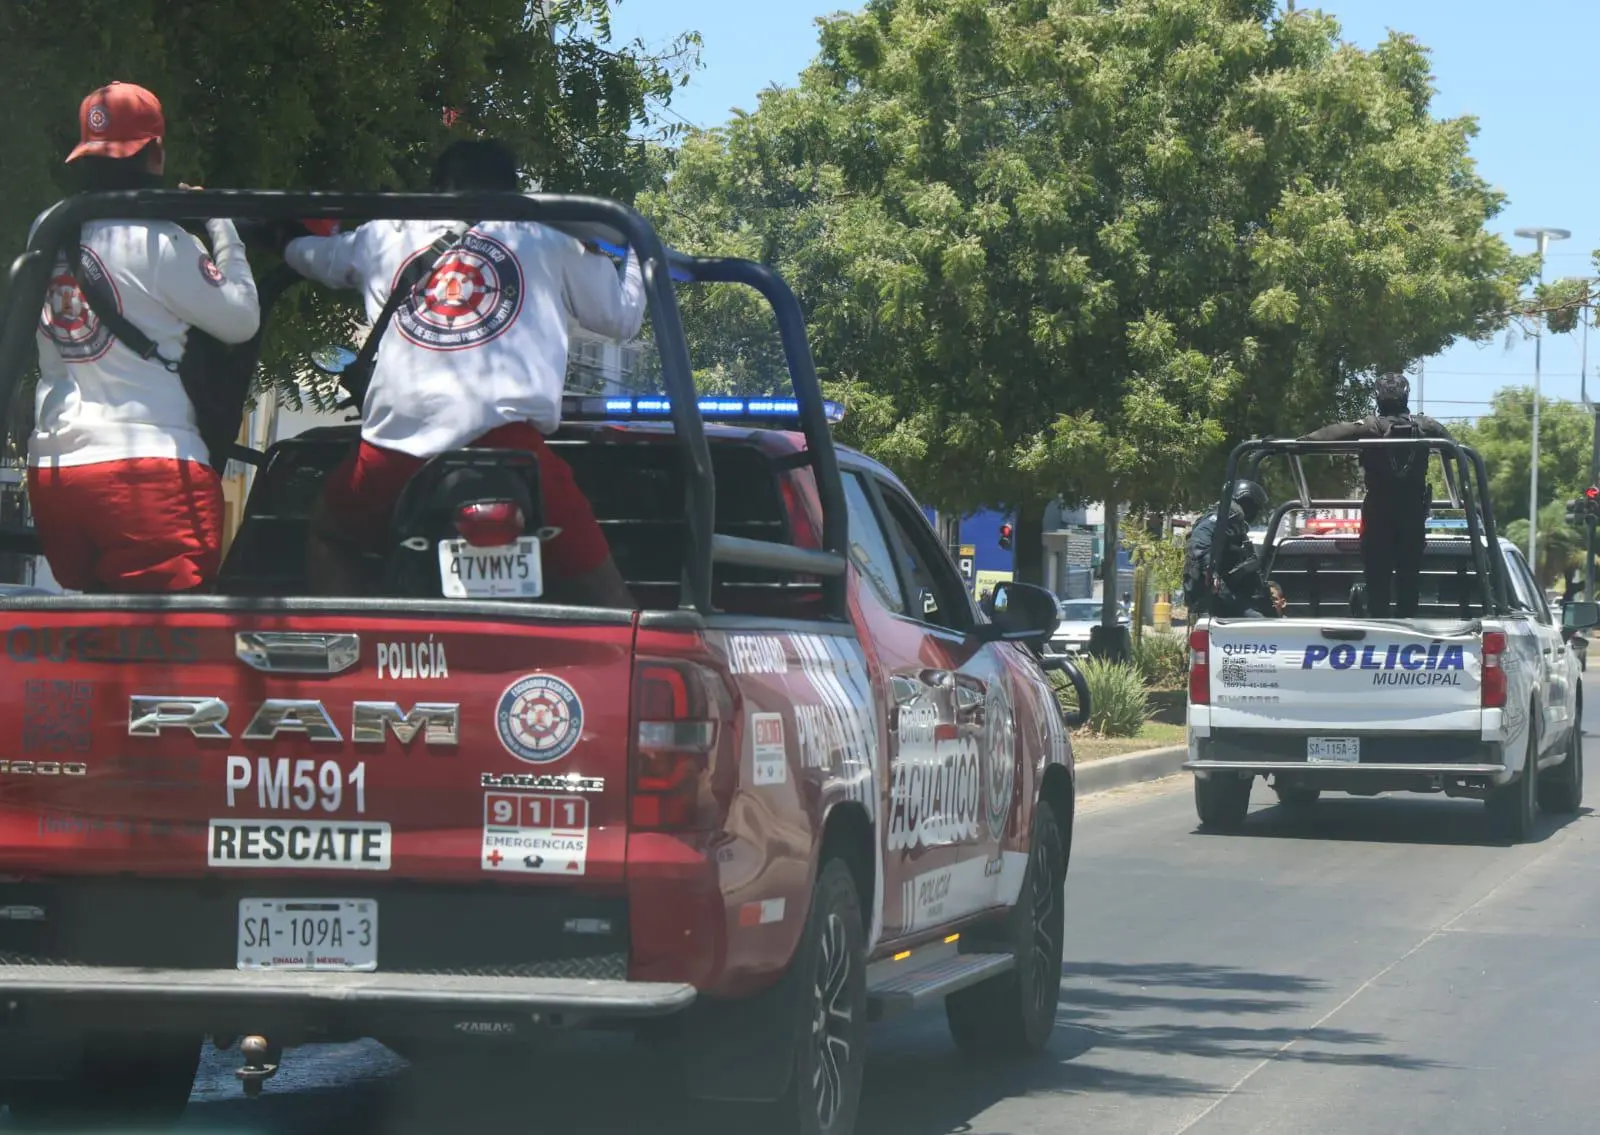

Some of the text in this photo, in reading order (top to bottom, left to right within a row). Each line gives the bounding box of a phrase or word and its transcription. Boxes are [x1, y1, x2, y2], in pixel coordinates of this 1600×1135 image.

[450, 554, 529, 580] 47VMY5
[6, 624, 202, 663] QUEJAS
[376, 633, 449, 680] POLICÍA
[1222, 643, 1278, 656] QUEJAS
[1301, 639, 1465, 670] POLICÍA
[1372, 672, 1461, 686] MUNICIPAL
[128, 695, 460, 745] RAM
[226, 755, 366, 813] PM591
[212, 825, 383, 862] RESCATE
[485, 835, 584, 851] EMERGENCIAS
[243, 917, 372, 948] SA-109A-3
[272, 956, 305, 965] SINALOA
